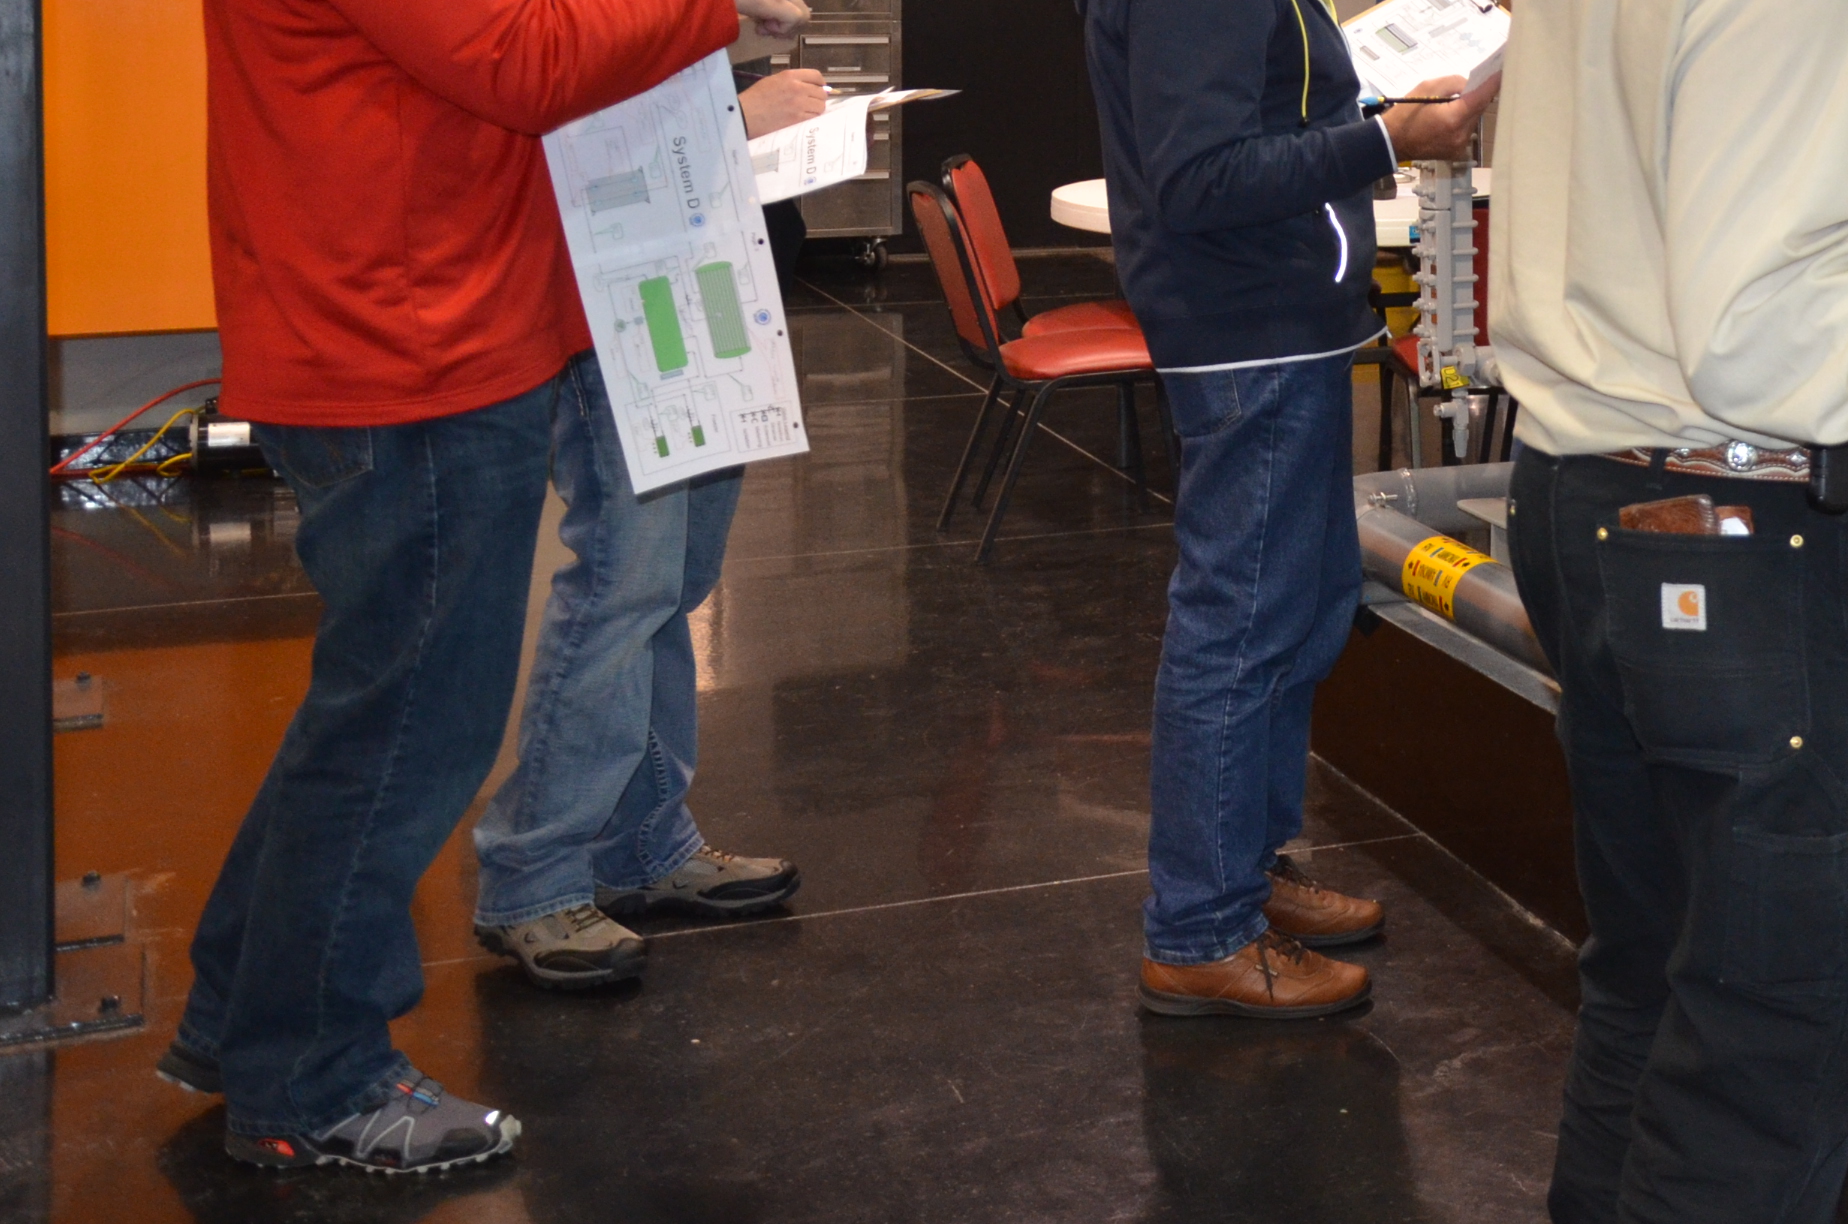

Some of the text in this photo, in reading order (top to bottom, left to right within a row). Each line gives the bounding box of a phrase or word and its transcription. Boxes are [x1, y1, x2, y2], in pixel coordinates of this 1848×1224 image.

[672, 136, 700, 209] System D
[806, 127, 819, 175] System D
